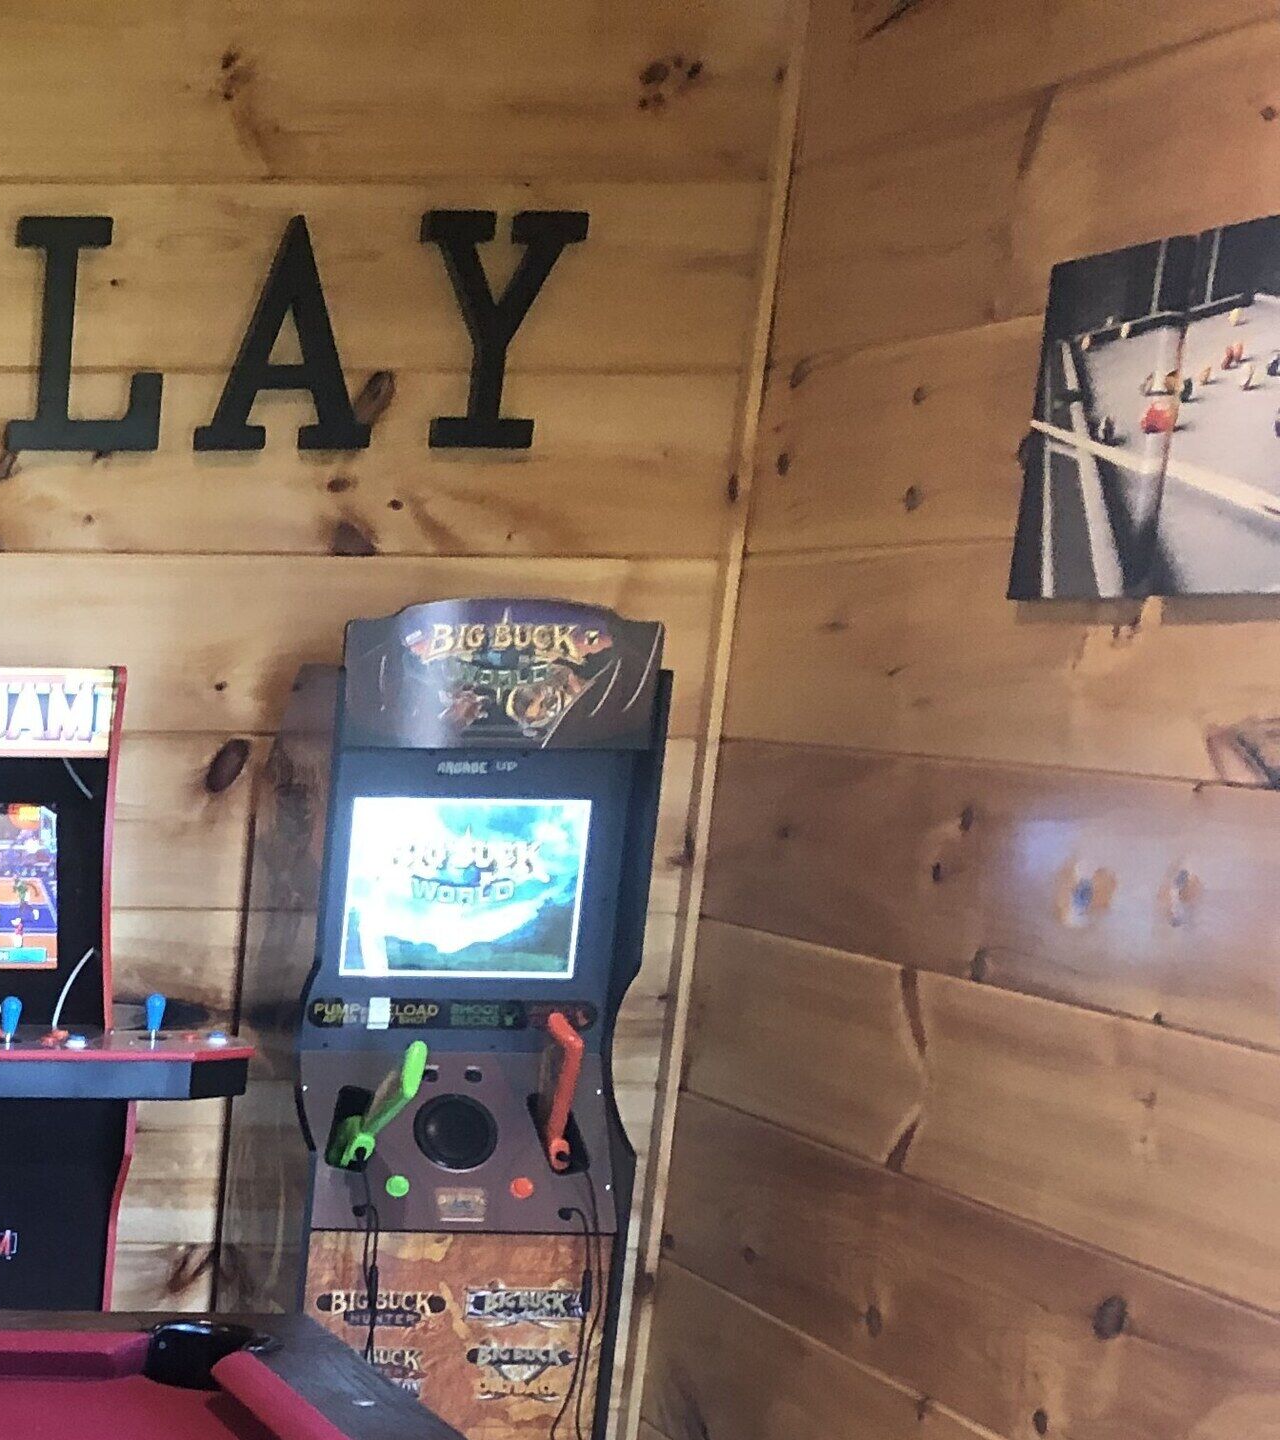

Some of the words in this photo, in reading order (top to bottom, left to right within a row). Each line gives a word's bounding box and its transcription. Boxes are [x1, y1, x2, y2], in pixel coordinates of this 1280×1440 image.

[421, 624, 485, 663] BIG
[492, 623, 587, 665] BUCK
[331, 1289, 370, 1315] BIG
[376, 1289, 433, 1317] BUCK
